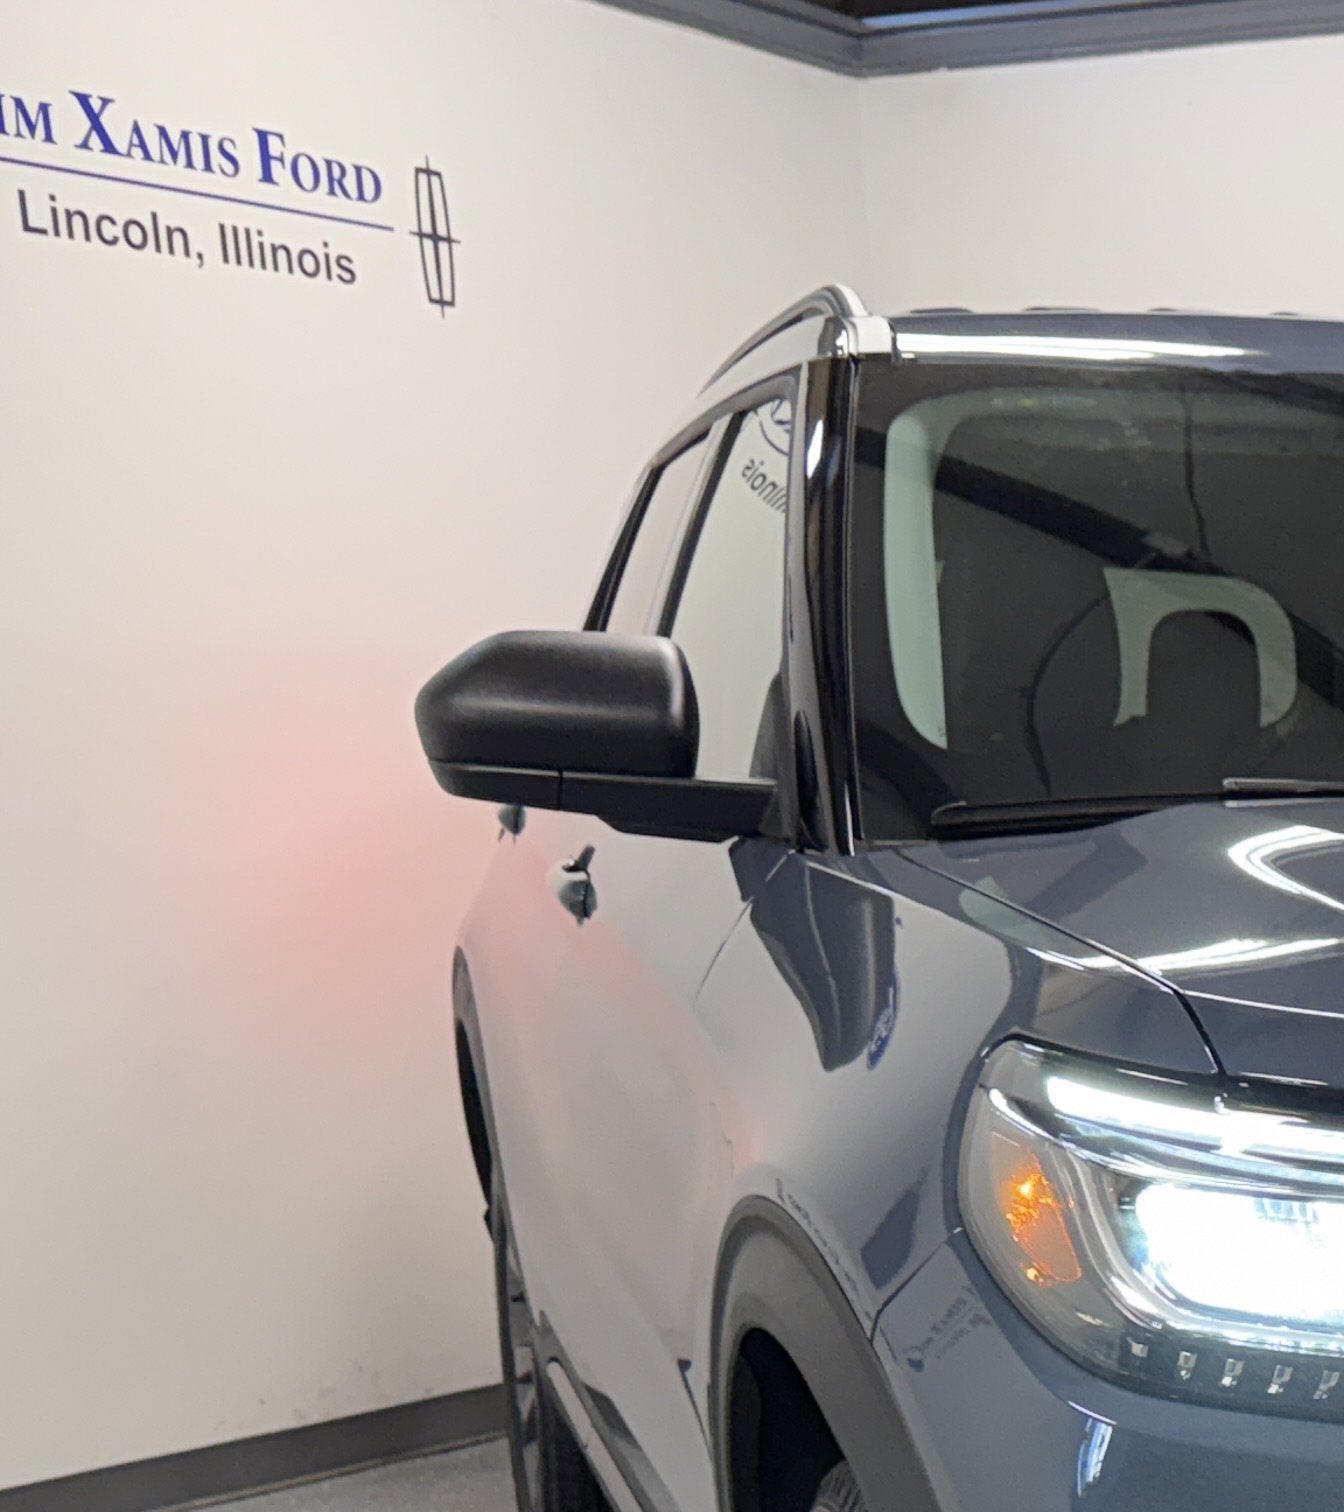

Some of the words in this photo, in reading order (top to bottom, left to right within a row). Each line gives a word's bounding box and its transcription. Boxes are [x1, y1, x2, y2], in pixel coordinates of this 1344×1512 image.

[68, 90, 240, 178] XAMIS
[252, 127, 383, 204] FORD
[17, 189, 205, 268] Lincoln,
[218, 222, 357, 285] Illinois
